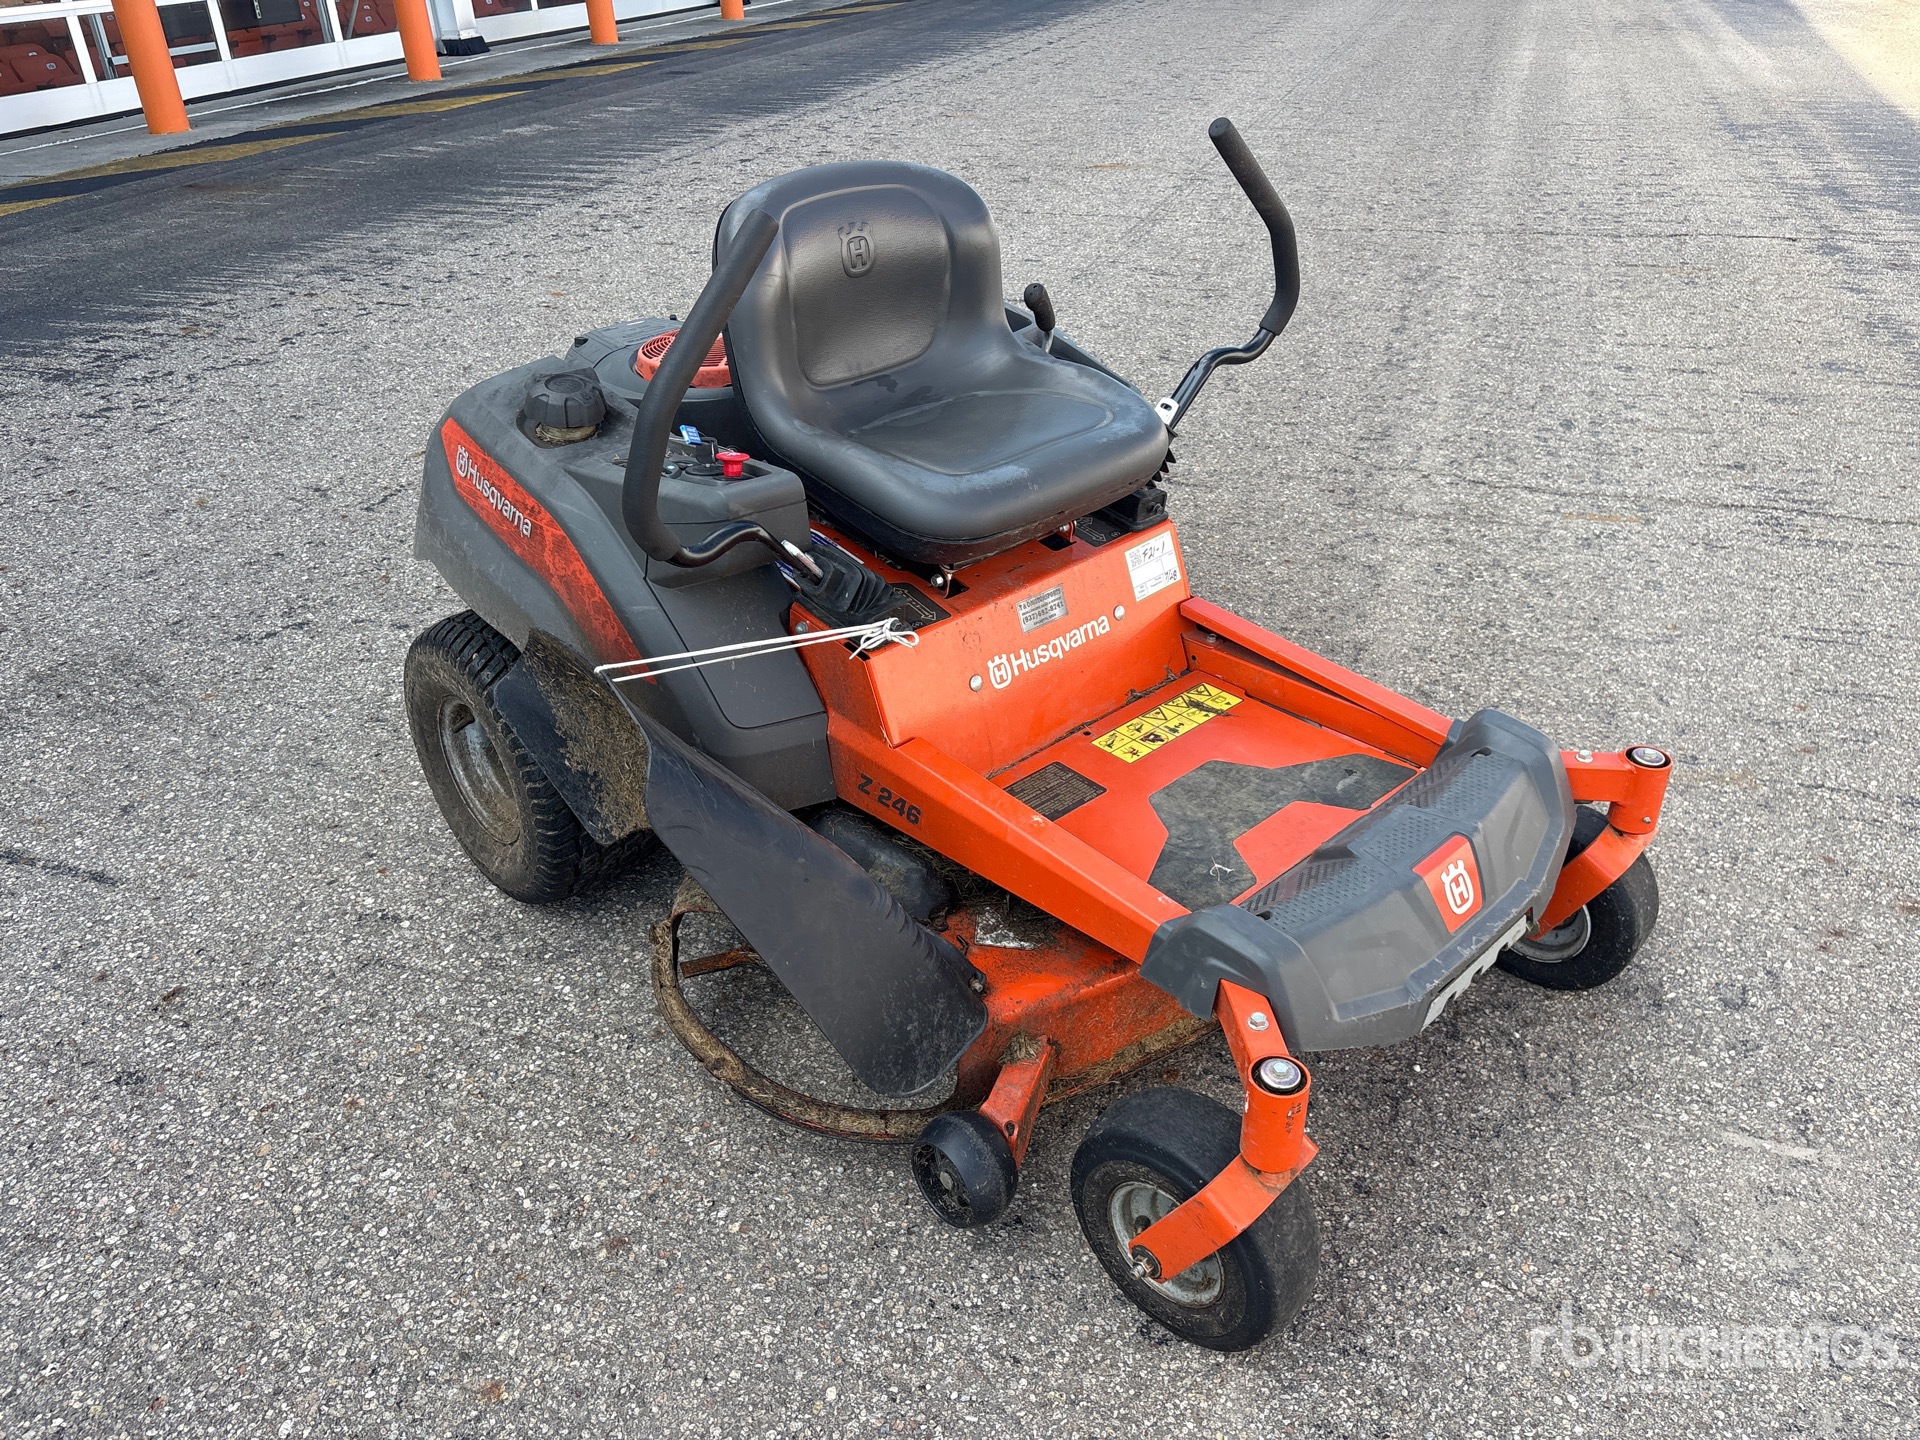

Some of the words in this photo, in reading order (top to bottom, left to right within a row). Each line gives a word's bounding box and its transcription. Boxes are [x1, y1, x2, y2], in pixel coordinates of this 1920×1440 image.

[467, 458, 532, 538] Husqvarna
[1010, 615, 1111, 676] Husqvarna
[858, 773, 874, 795] Z
[877, 787, 922, 825] 246
